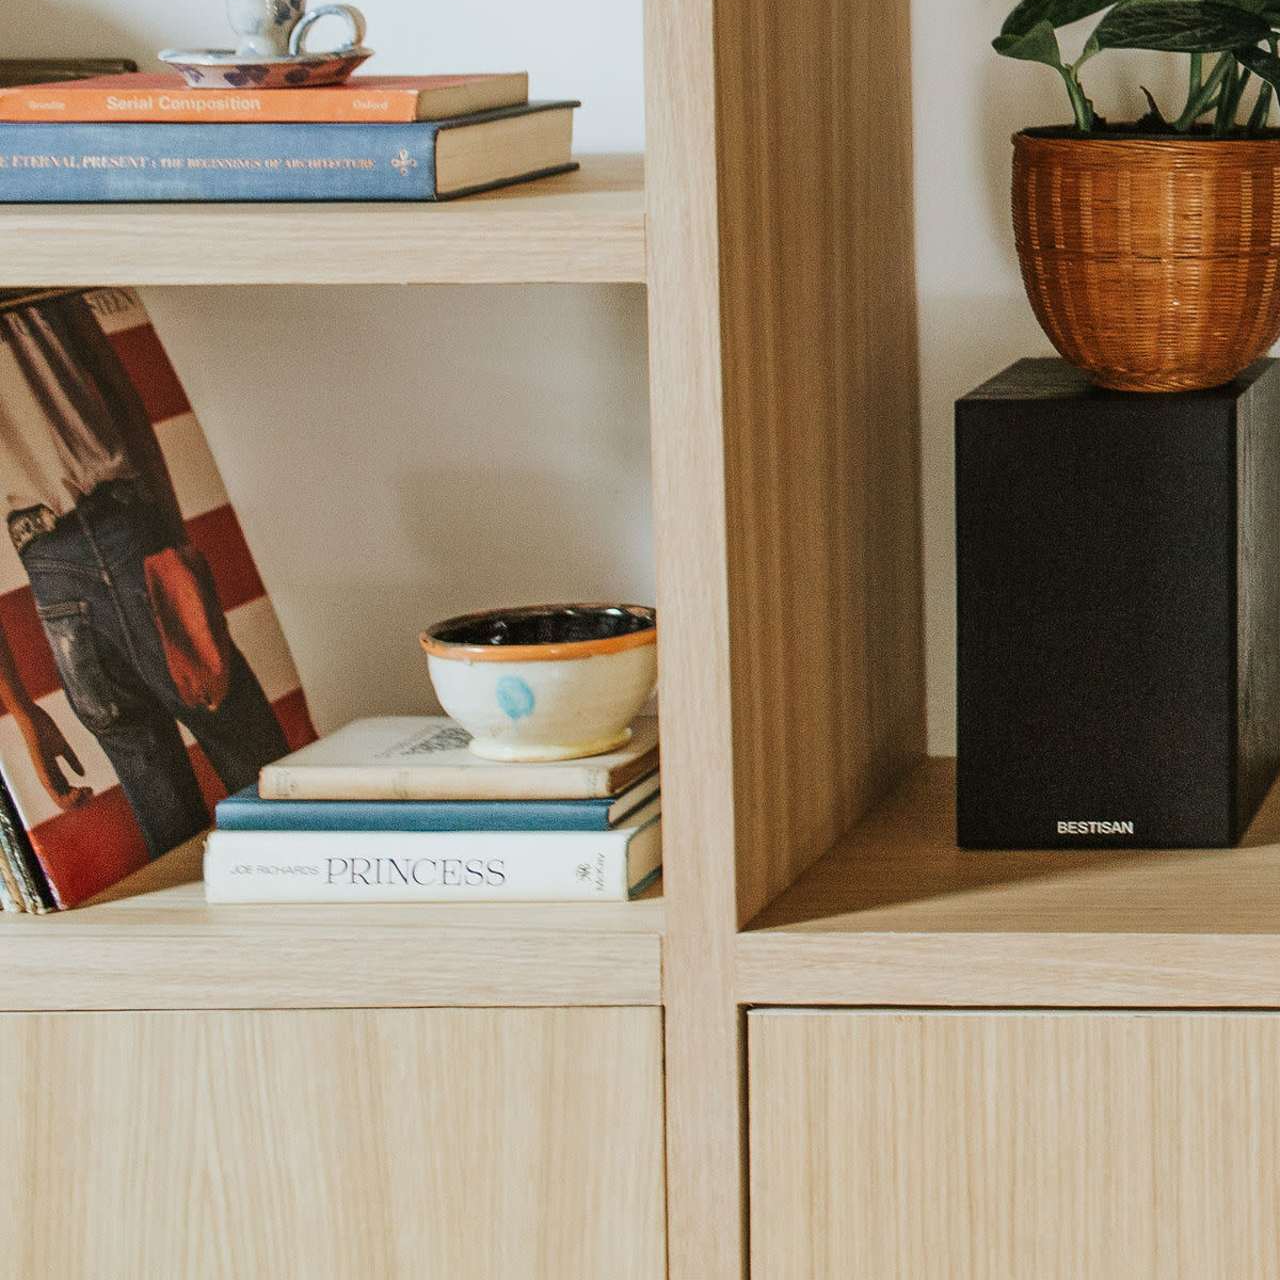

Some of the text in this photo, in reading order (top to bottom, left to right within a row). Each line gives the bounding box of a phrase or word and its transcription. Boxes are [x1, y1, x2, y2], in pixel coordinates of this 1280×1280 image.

[106, 94, 153, 111] Serial
[158, 94, 262, 114] Composition
[82, 154, 147, 169] PRESENT
[1056, 820, 1135, 835] BESTISAN
[324, 856, 507, 888] PRINCESS
